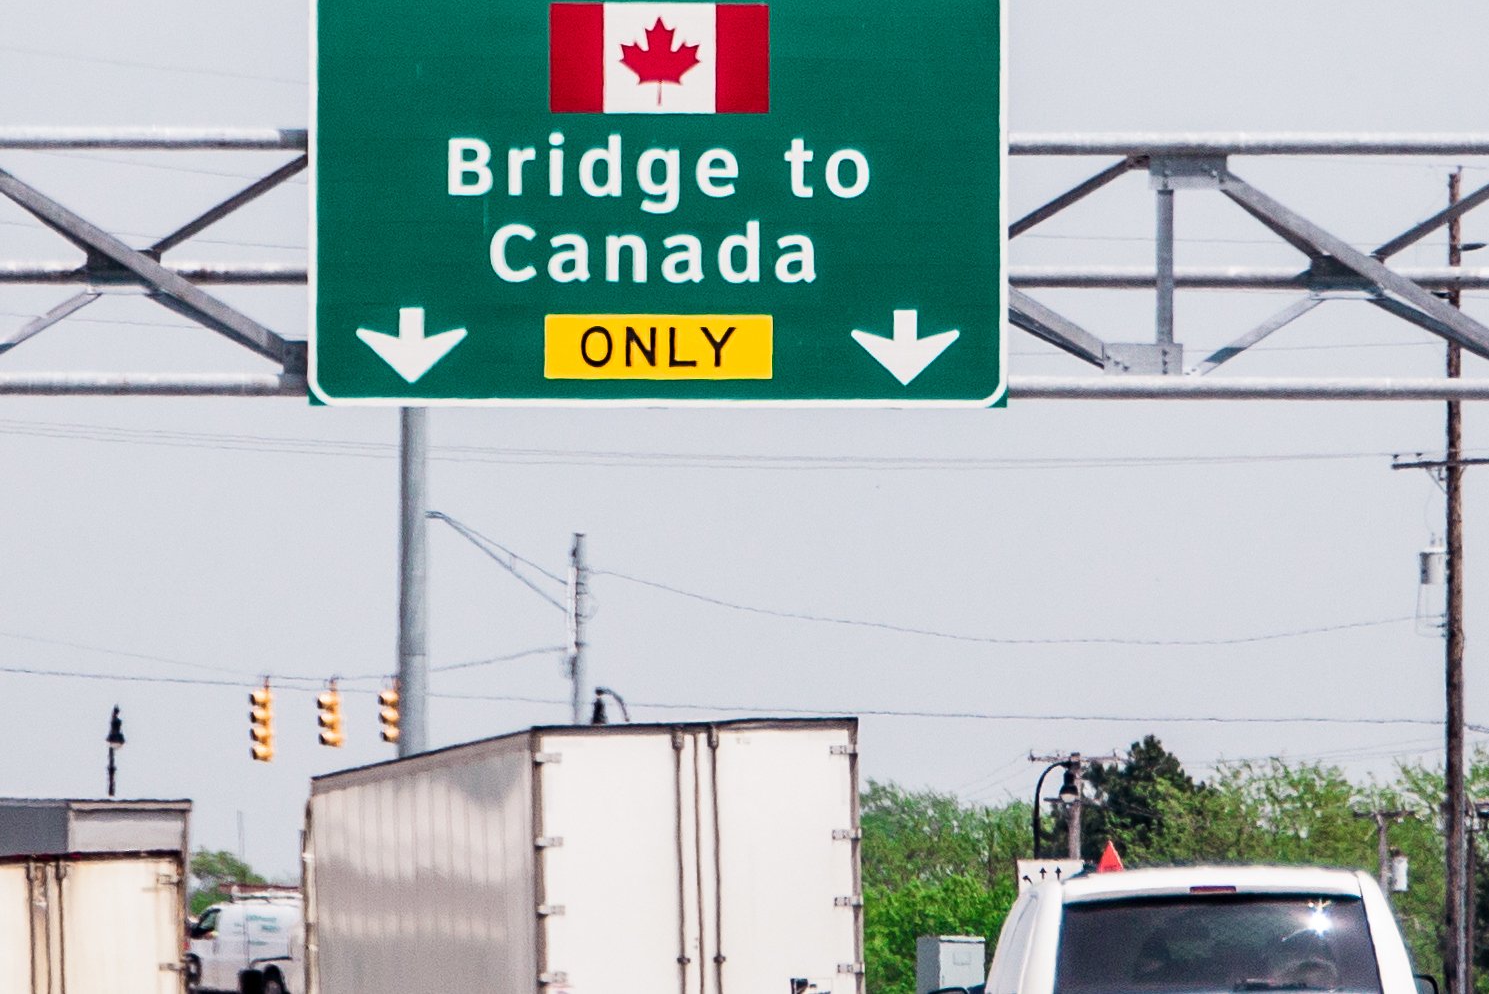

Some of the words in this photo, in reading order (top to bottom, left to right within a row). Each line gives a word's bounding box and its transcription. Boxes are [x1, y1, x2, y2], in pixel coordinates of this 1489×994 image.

[448, 133, 739, 214] Bridge
[784, 138, 870, 199] to
[490, 221, 817, 284] Canada
[581, 326, 737, 368] ONLY
